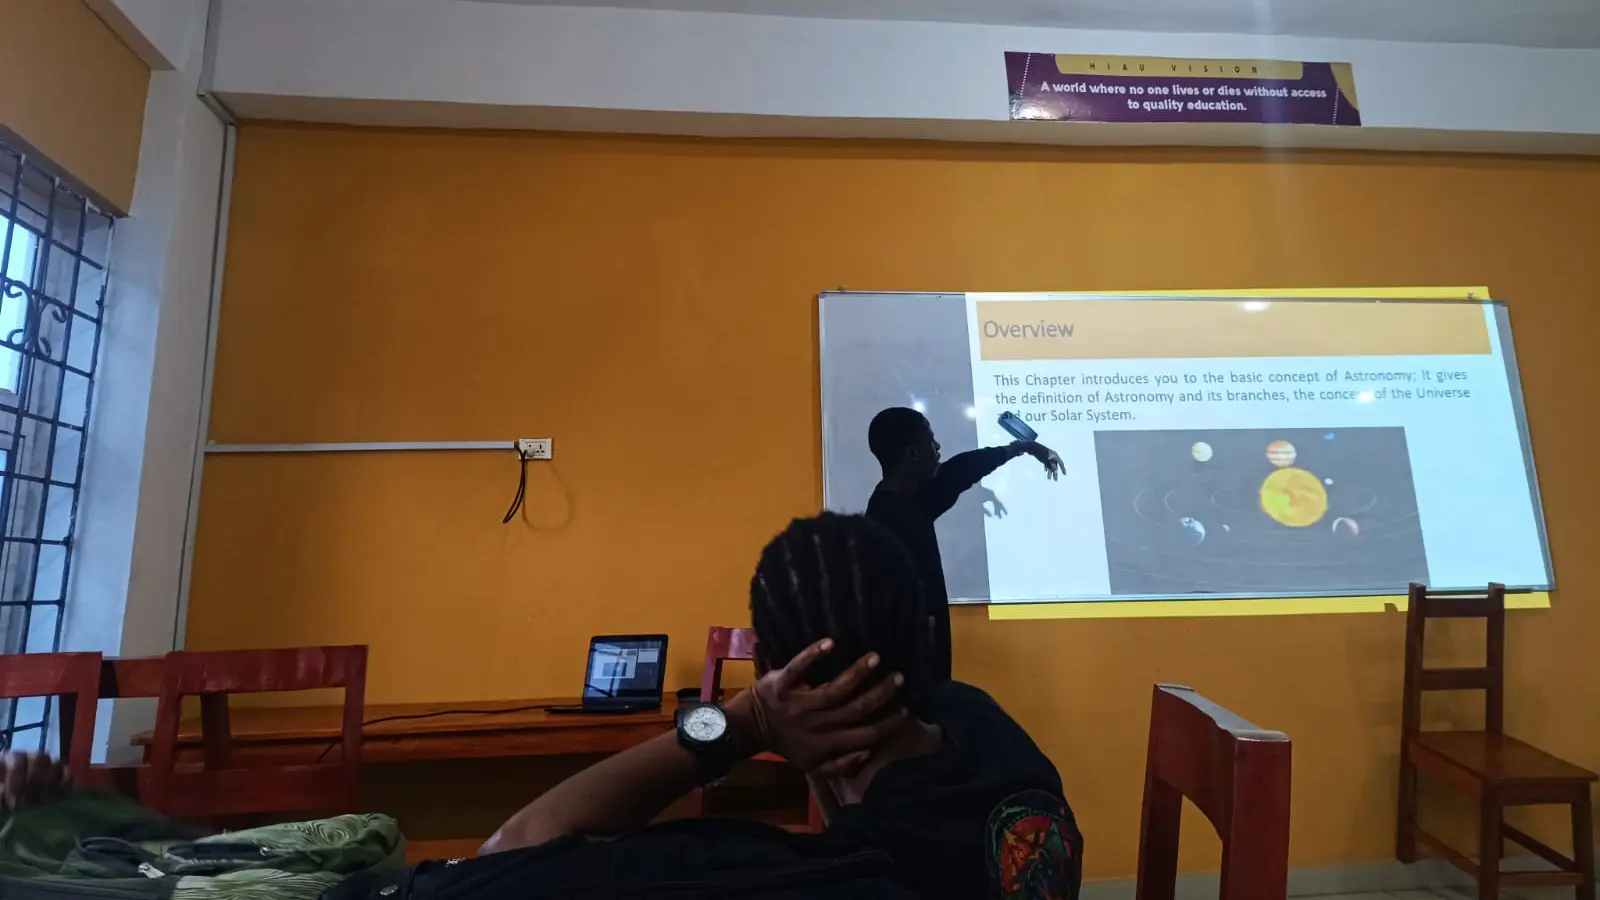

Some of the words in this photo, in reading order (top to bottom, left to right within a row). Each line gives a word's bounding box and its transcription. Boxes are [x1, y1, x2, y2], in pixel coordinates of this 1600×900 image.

[1041, 81, 1050, 92] A
[1052, 82, 1087, 94] world
[1089, 83, 1126, 94] where
[1129, 86, 1144, 95] no
[1147, 87, 1170, 95] one
[1172, 85, 1200, 96] lives
[1202, 88, 1214, 96] or
[1218, 86, 1241, 97] dies
[1244, 86, 1288, 97] without
[1291, 89, 1327, 98] access
[1127, 99, 1140, 110] to
[1142, 99, 1184, 113] quality
[1187, 100, 1247, 111] education.
[983, 320, 1074, 338] Overview
[994, 374, 1019, 386] This
[1025, 374, 1076, 388] Chapter
[1082, 373, 1148, 385] introduces
[1154, 374, 1177, 387] you
[1184, 373, 1197, 384] to
[1204, 372, 1224, 383] the
[1230, 371, 1263, 383] basic
[1269, 371, 1320, 384] concept
[1325, 370, 1338, 382] of
[1344, 370, 1416, 384] Astronomy;
[1422, 369, 1431, 380] It
[1437, 369, 1467, 382] gives
[995, 393, 1016, 405] the
[1022, 391, 1082, 404] definition
[1087, 391, 1100, 402] of
[1105, 391, 1174, 404] Astronomy
[1179, 390, 1202, 401] and
[1207, 390, 1222, 401] its
[1227, 389, 1289, 402] branches,
[1294, 388, 1314, 400] the
[1320, 390, 1371, 403] conce
[1392, 387, 1412, 399] the
[1416, 387, 1470, 398] Universe
[1025, 410, 1047, 421] our
[1051, 409, 1082, 421] Solar
[1087, 409, 1136, 423] System.
